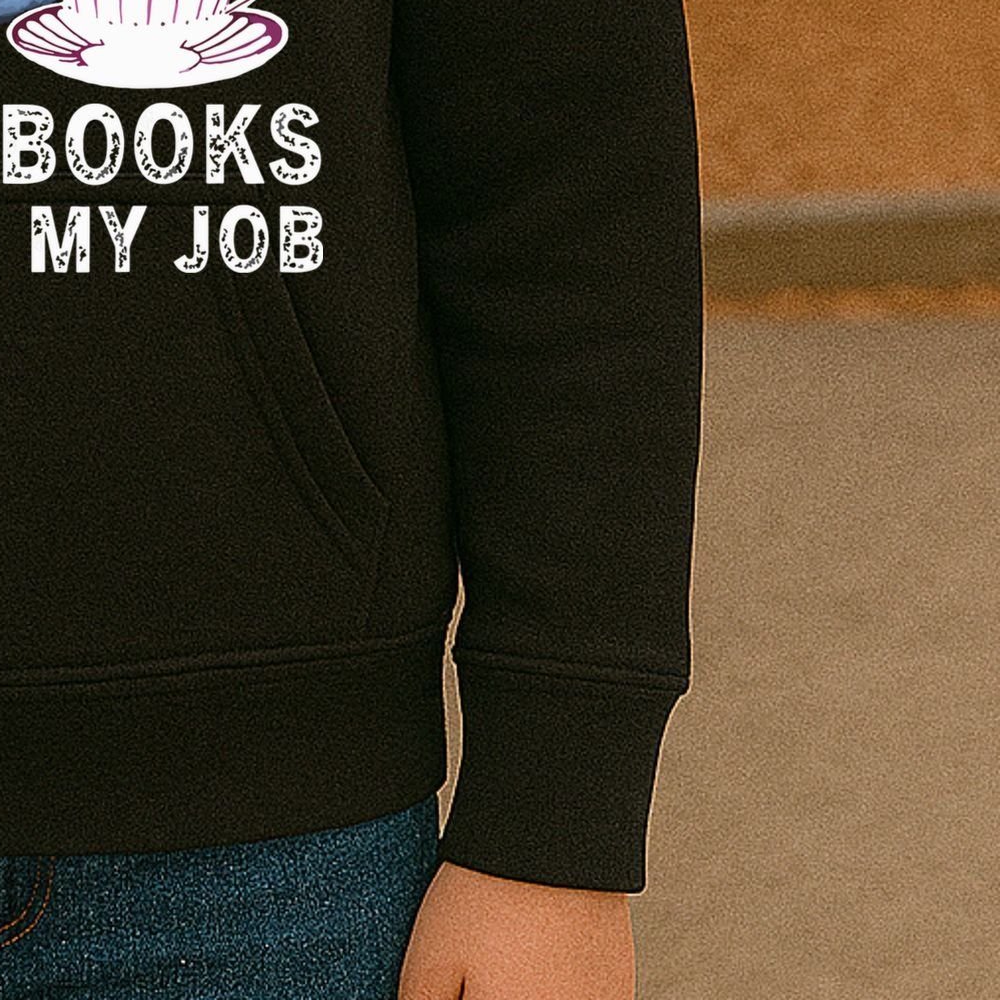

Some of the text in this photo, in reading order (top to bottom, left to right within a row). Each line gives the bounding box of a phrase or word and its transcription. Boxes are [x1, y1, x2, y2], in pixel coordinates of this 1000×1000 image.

[2, 102, 321, 185] BOOKS
[31, 205, 147, 272] MY
[173, 204, 323, 273] JOB
